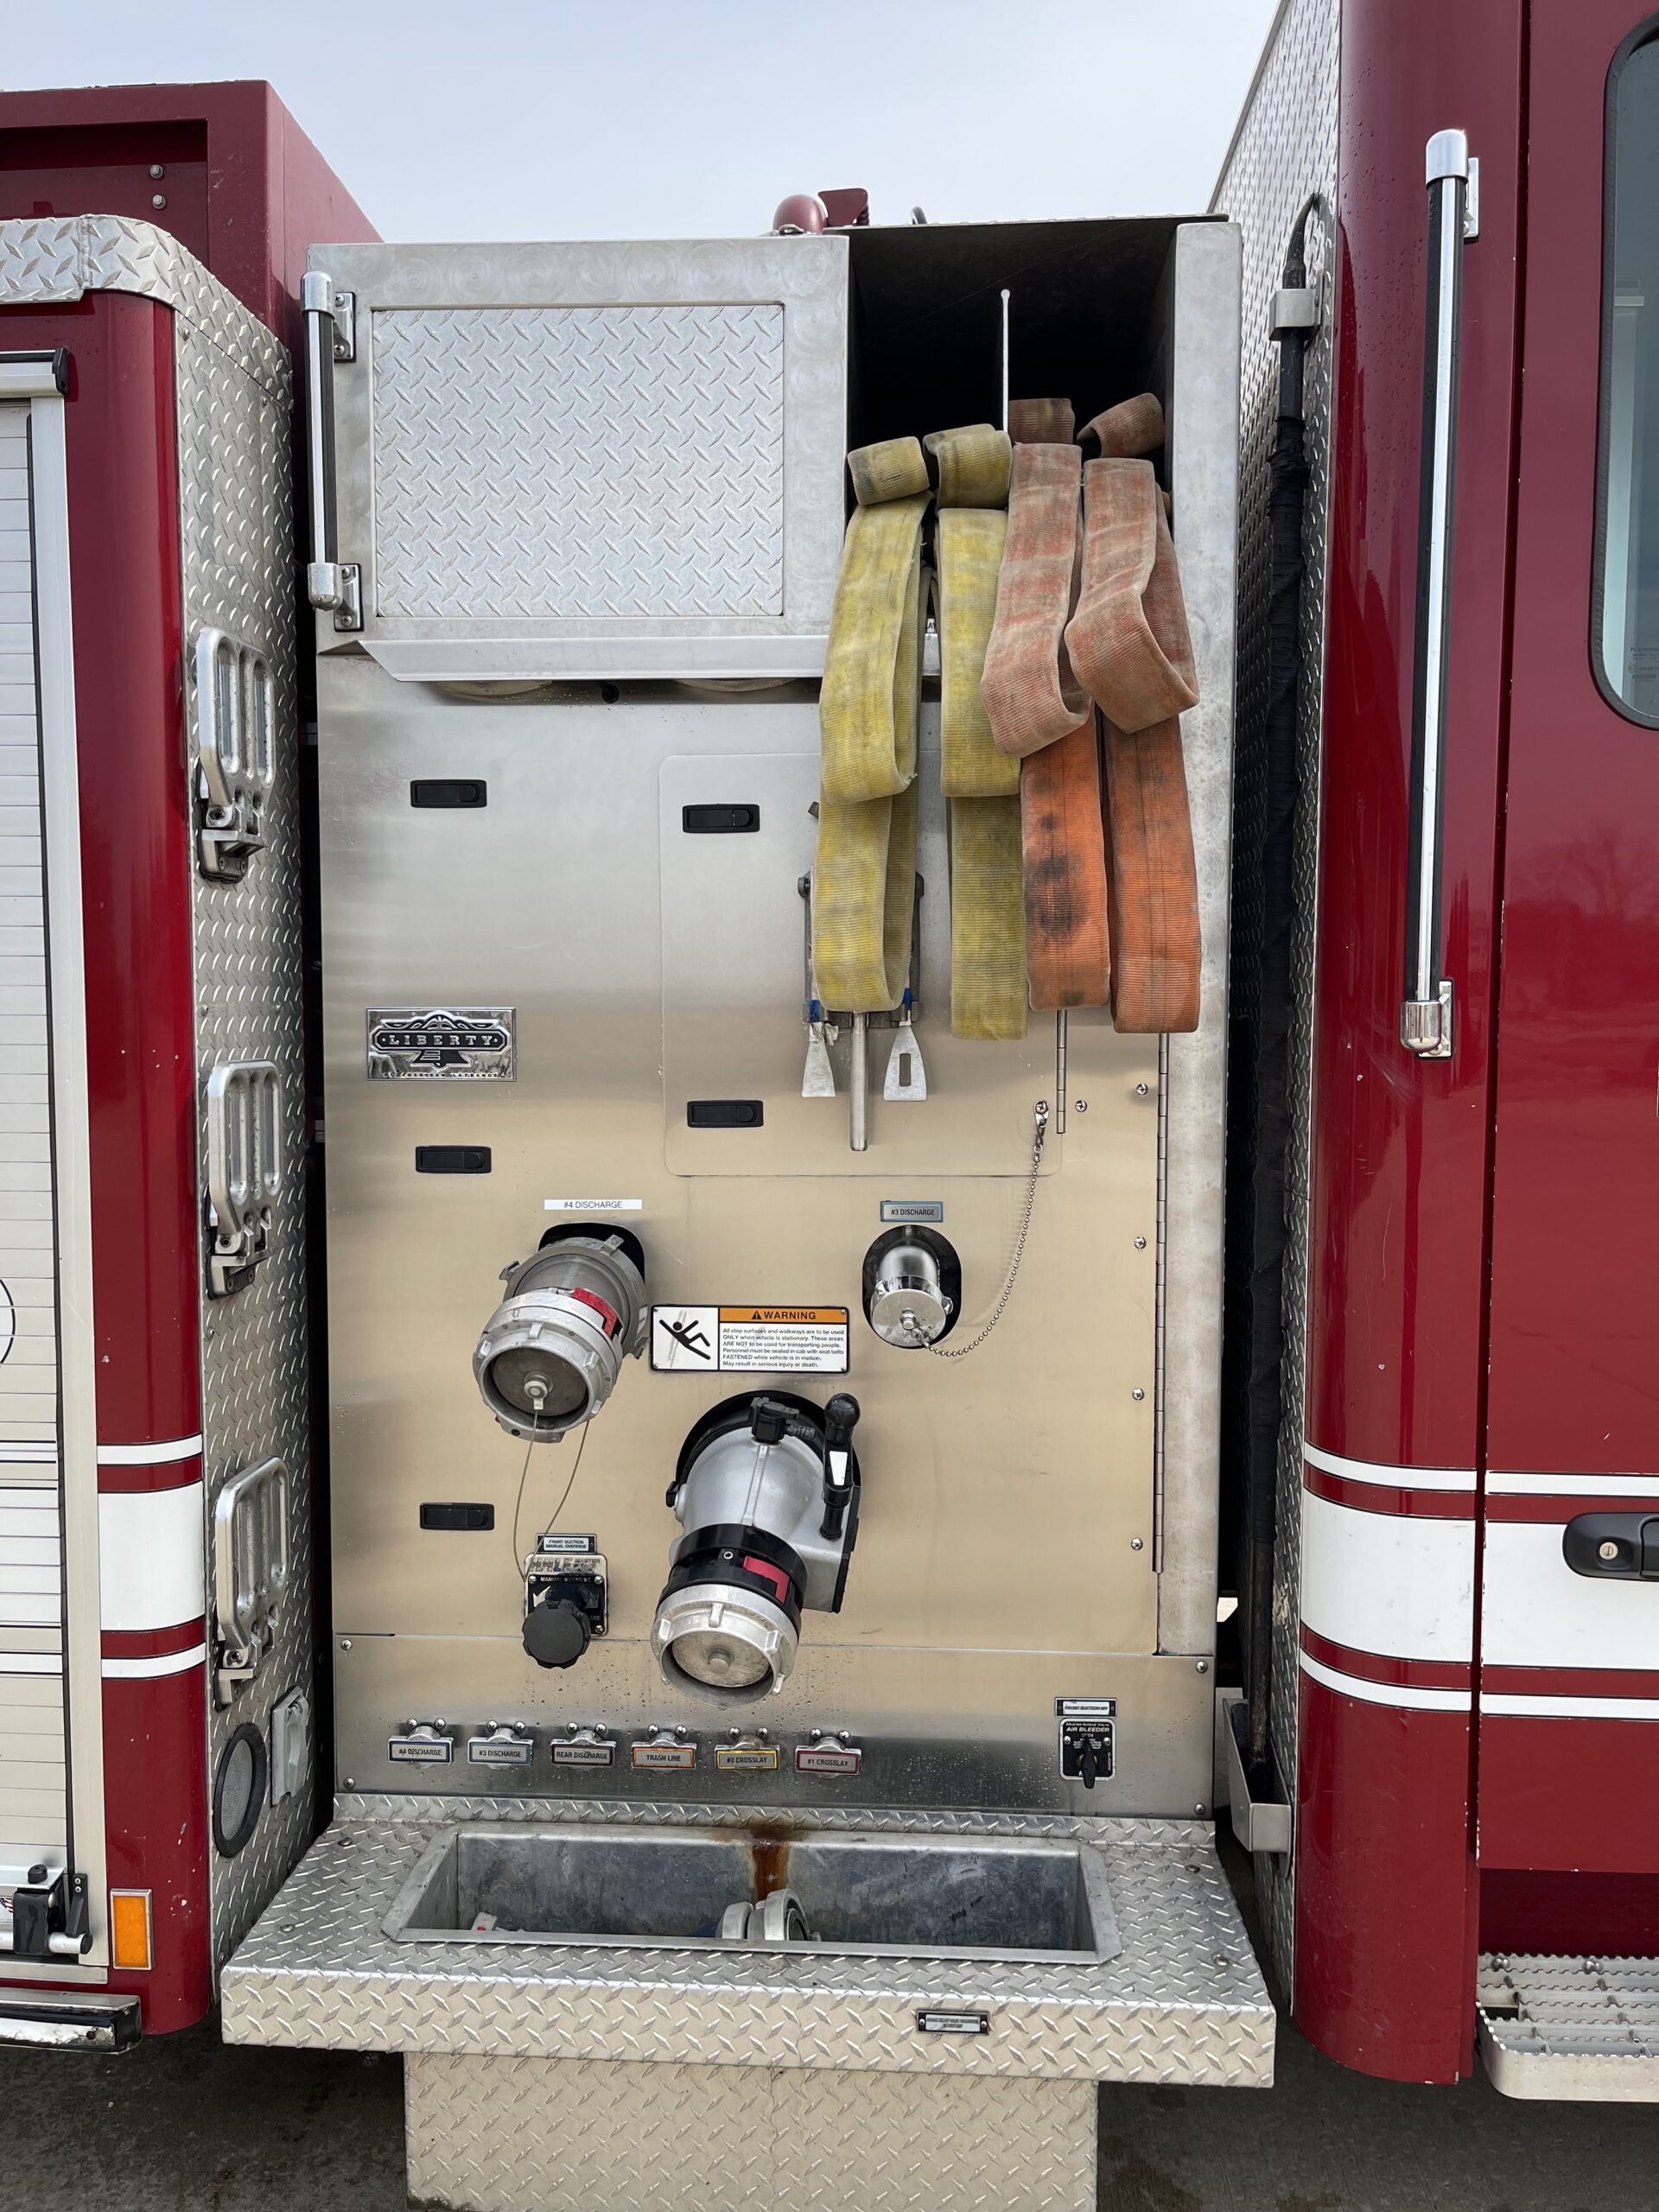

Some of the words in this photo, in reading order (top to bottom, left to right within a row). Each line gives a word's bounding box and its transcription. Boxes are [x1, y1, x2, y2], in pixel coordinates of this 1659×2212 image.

[389, 1034, 493, 1046] LIBERTY
[764, 1311, 817, 1320] WARNING
[408, 1748, 442, 1757] DISCHARGE
[574, 1751, 607, 1760] DISCHARGE
[817, 1758, 849, 1767] CROSSLAY
